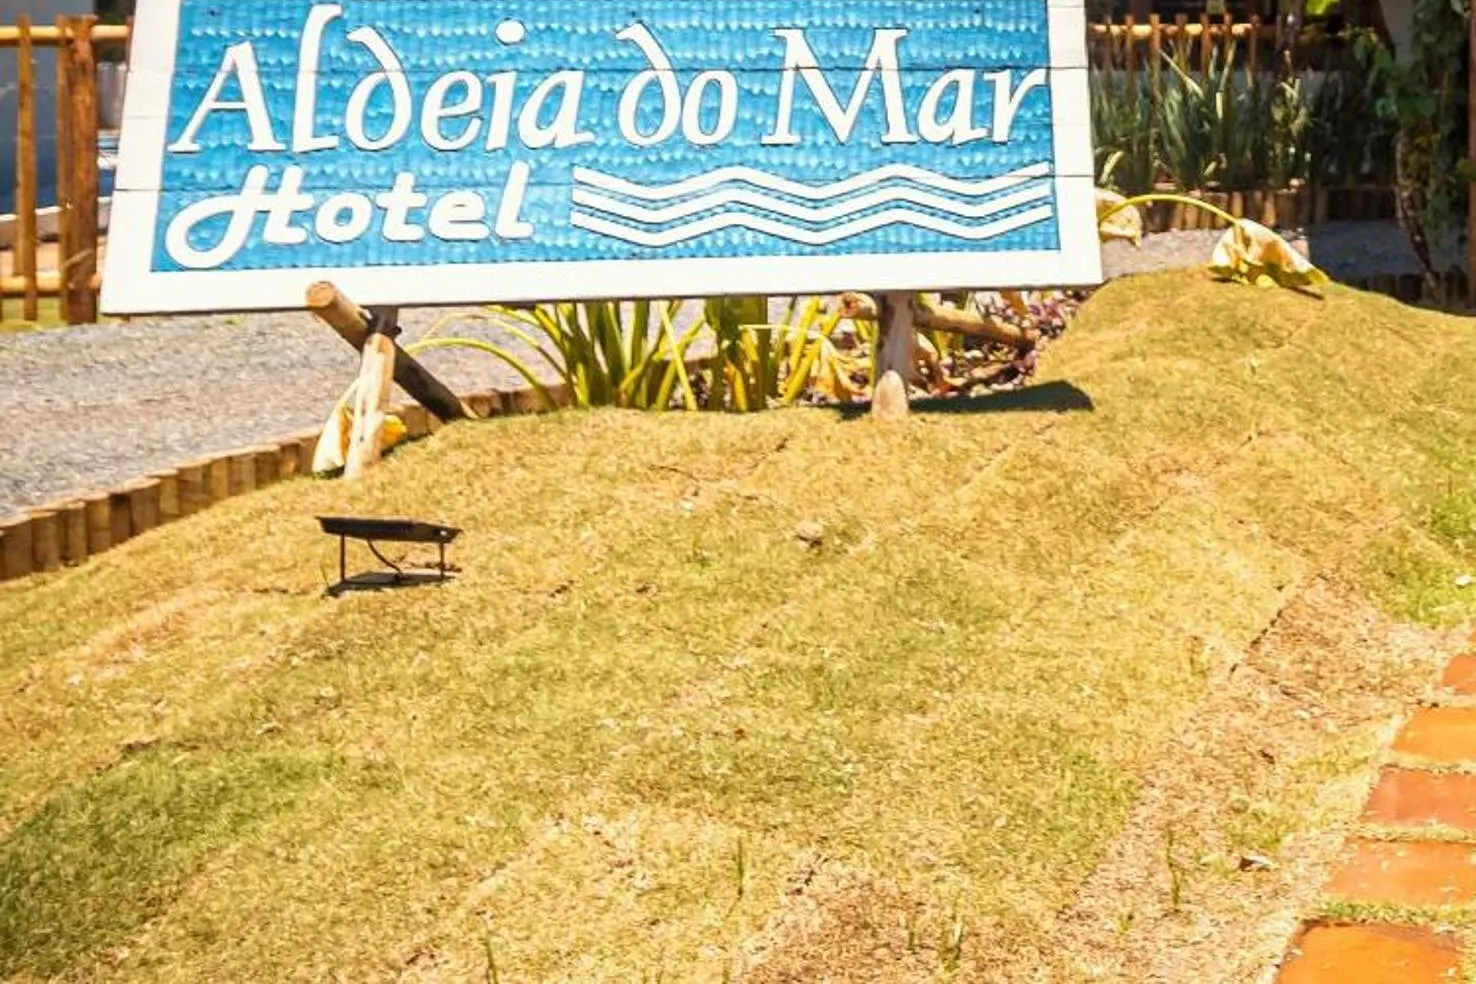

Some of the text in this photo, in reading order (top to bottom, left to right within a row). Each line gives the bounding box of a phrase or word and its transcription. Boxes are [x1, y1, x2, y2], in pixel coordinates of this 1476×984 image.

[168, 3, 1048, 154] Aldeia do Mar
[164, 163, 534, 270] Hotel
